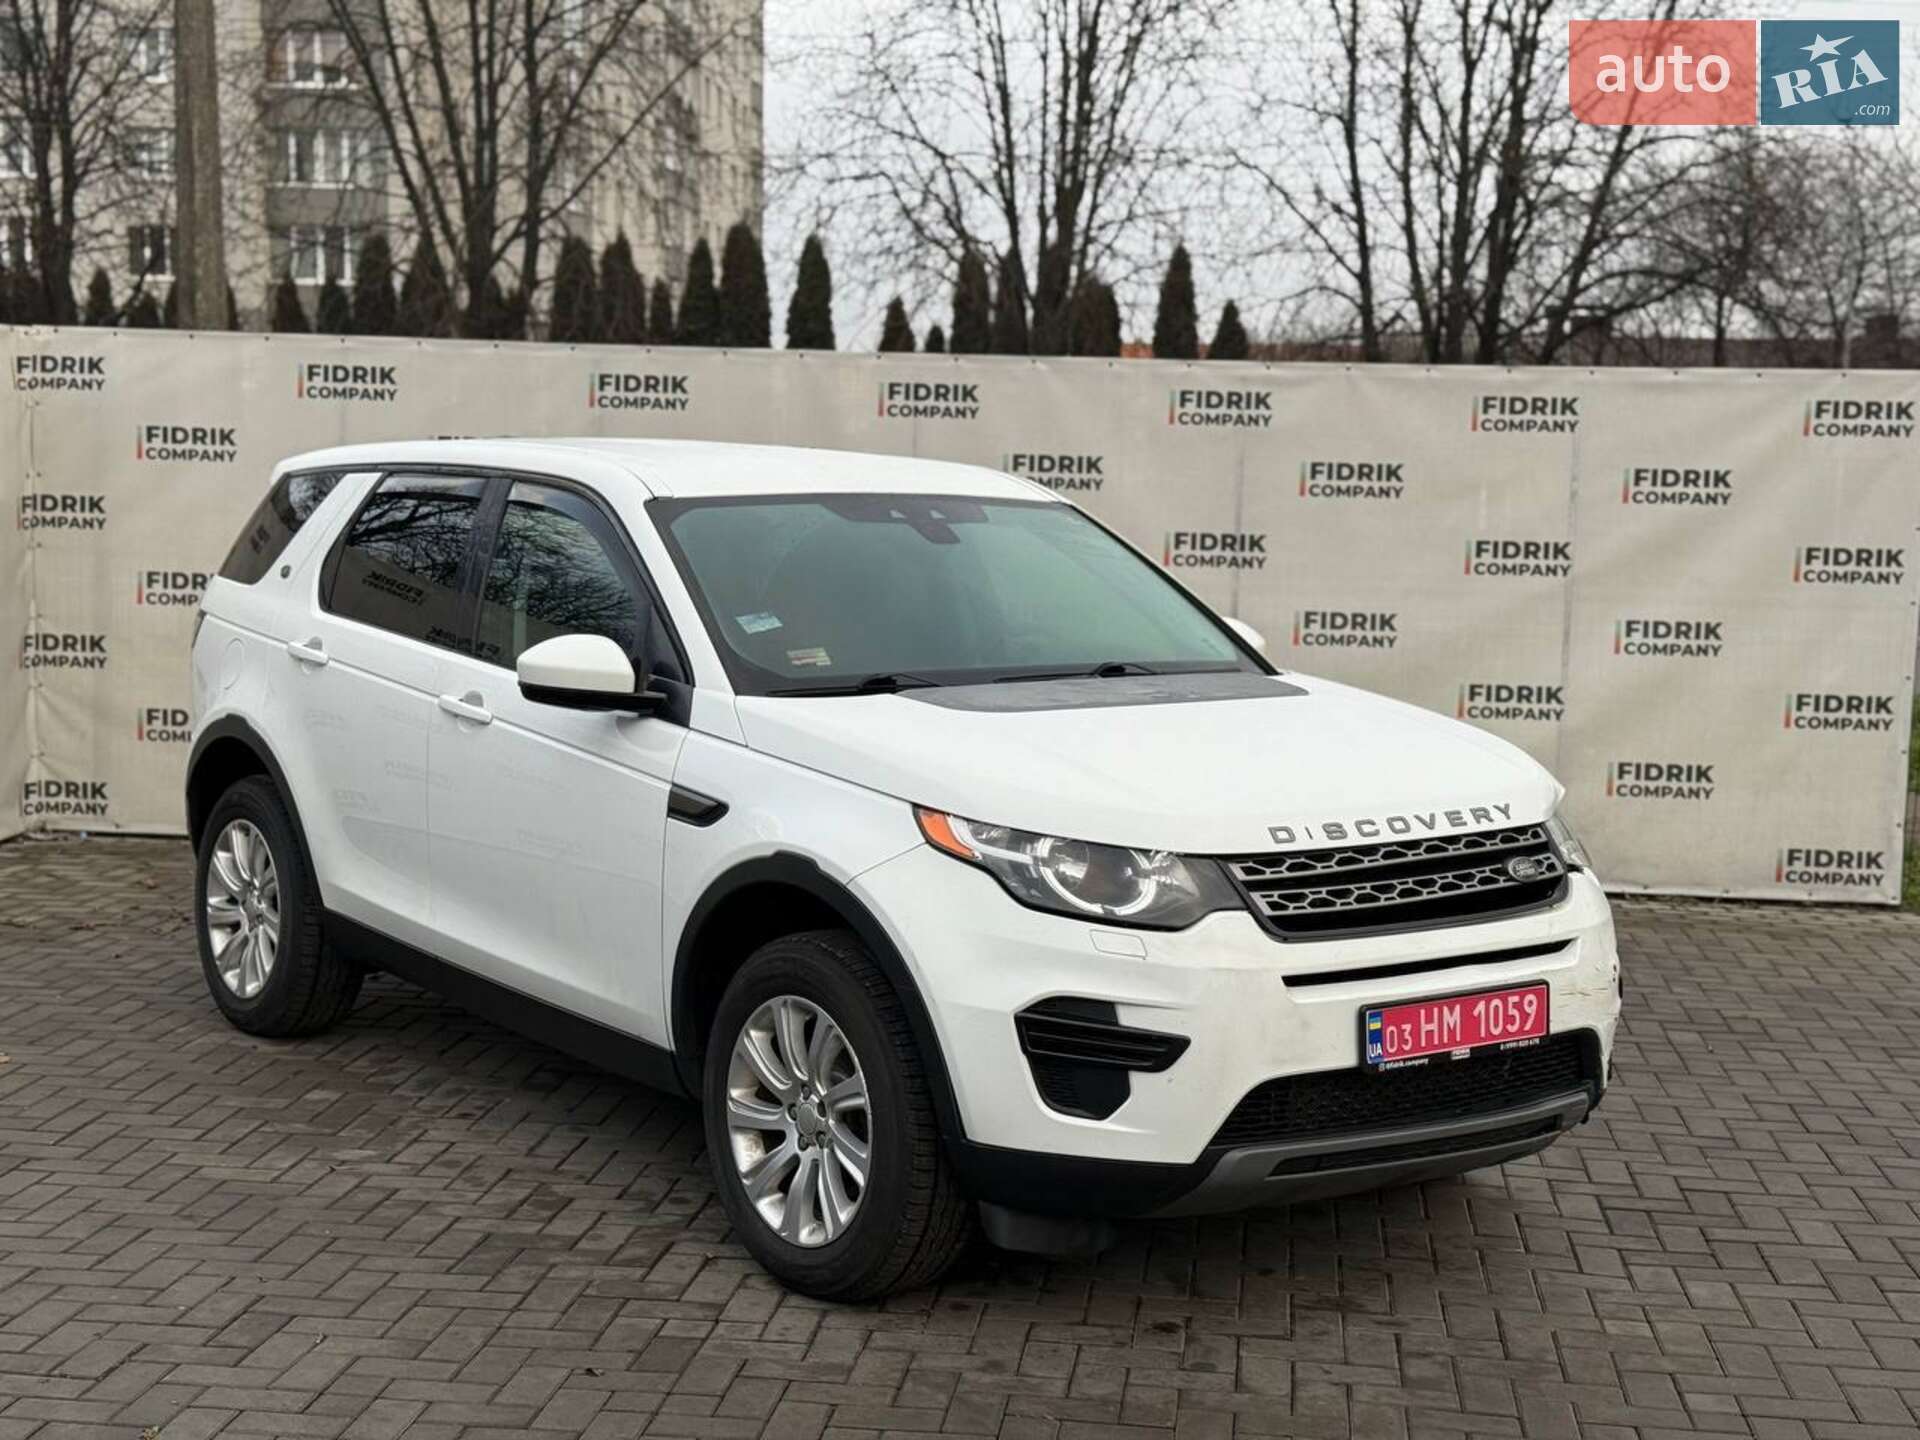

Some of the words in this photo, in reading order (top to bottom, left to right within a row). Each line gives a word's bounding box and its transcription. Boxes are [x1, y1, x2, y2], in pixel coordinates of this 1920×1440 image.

[17, 355, 104, 374] FIDRIK
[17, 377, 104, 390] COMPANY
[308, 365, 395, 384] FIDRIK
[599, 374, 687, 394] FIDRIK
[307, 386, 396, 400] COMPANY
[889, 383, 978, 402] FIDRIK
[1180, 390, 1271, 410] FIDRIK
[598, 396, 688, 410] COMPANY
[888, 405, 978, 418] COMPANY
[1483, 396, 1578, 416] FIDRIK
[1815, 401, 1914, 420] FIDRIK
[1178, 412, 1271, 426] COMPANY
[1481, 419, 1578, 432] COMPANY
[146, 426, 235, 446] FIDRIK
[1814, 424, 1913, 437] COMPANY
[146, 448, 236, 461] COMPANY
[1013, 454, 1102, 474] FIDRIK
[1310, 462, 1403, 482] FIDRIK
[1634, 469, 1731, 488] FIDRIK
[1309, 485, 1403, 498] COMPANY
[1632, 491, 1731, 504] COMPANY
[22, 494, 104, 513] FIDRIK
[22, 516, 106, 530] COMPANY
[1174, 533, 1265, 552] FIDRIK
[1476, 541, 1570, 560] FIDRIK
[1173, 555, 1265, 568] COMPANY
[1806, 547, 1903, 567] FIDRIK
[1474, 563, 1570, 576] COMPANY
[1804, 570, 1903, 584] COMPANY
[147, 571, 213, 590] FIDR
[1304, 611, 1396, 631] FIDRIK
[1626, 620, 1722, 640] FIDRIK
[23, 633, 106, 653] FIDRIK
[1303, 633, 1396, 648] COMPANY
[1624, 643, 1721, 656] COMPANY
[23, 654, 107, 669] COMPANY
[1469, 684, 1563, 704] FIDRIK
[1468, 706, 1564, 720] COMPANY
[1796, 694, 1892, 714] FIDRIK
[147, 708, 189, 727] FID
[1795, 716, 1892, 730] COMPANY
[1618, 763, 1713, 783] FIDRIK
[24, 781, 107, 800] FIDRIK
[1616, 785, 1713, 799] COMPANY
[24, 802, 108, 816] COMPANY
[1268, 803, 1512, 844] DISCOVERY
[1787, 849, 1883, 869] FIDRIK
[1785, 870, 1883, 886] COMPANY
[1386, 1024, 1412, 1053] 03
[1420, 1004, 1461, 1047] HM
[1473, 994, 1537, 1038] 1059
[1369, 1043, 1382, 1058] UA
